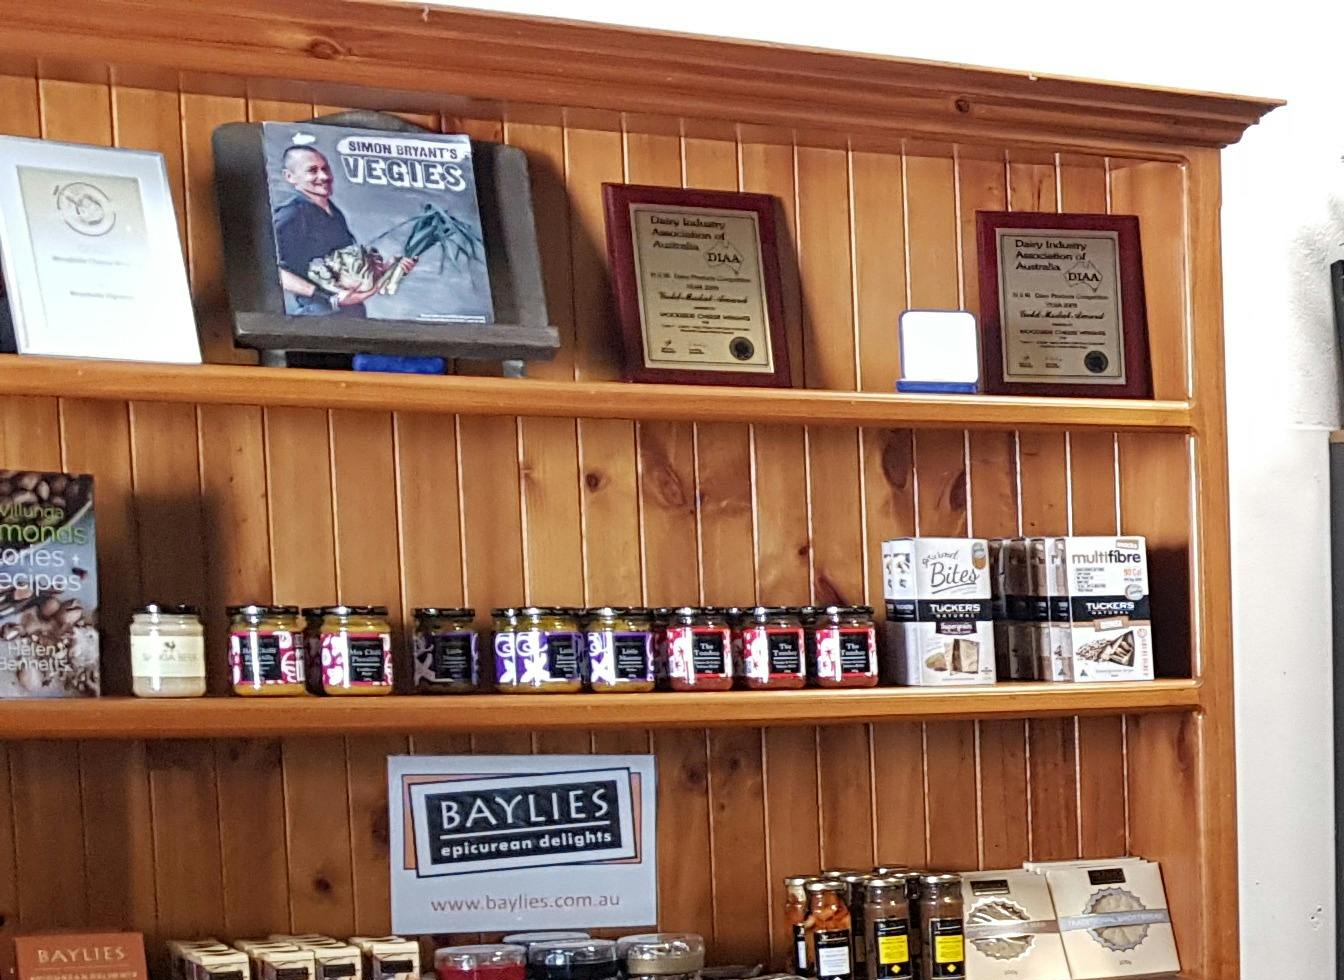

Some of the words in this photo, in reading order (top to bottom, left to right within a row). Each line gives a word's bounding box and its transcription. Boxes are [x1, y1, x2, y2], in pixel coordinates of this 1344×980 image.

[349, 141, 391, 154] SIMON
[396, 145, 457, 159] BRYANT'S
[342, 155, 466, 191] VEGIES
[715, 232, 725, 240] of
[1015, 240, 1042, 249] Dairy
[1046, 241, 1087, 251] Industry
[707, 253, 740, 263] DIAA
[1016, 251, 1072, 260] Association
[1075, 252, 1087, 261] of
[1016, 262, 1060, 271] Australia
[1068, 272, 1099, 281] DIAA
[1072, 551, 1141, 564] multifibre
[931, 563, 980, 588] Bites
[930, 603, 981, 612] TUCKERS
[1086, 602, 1135, 611] TUCKERS
[7, 640, 55, 657] Helen
[440, 788, 609, 830] BAYLIES
[441, 839, 532, 858] epicurean
[539, 830, 612, 849] delights
[431, 894, 620, 913] www.baylies.com.au
[38, 946, 125, 962] BAYLIES
